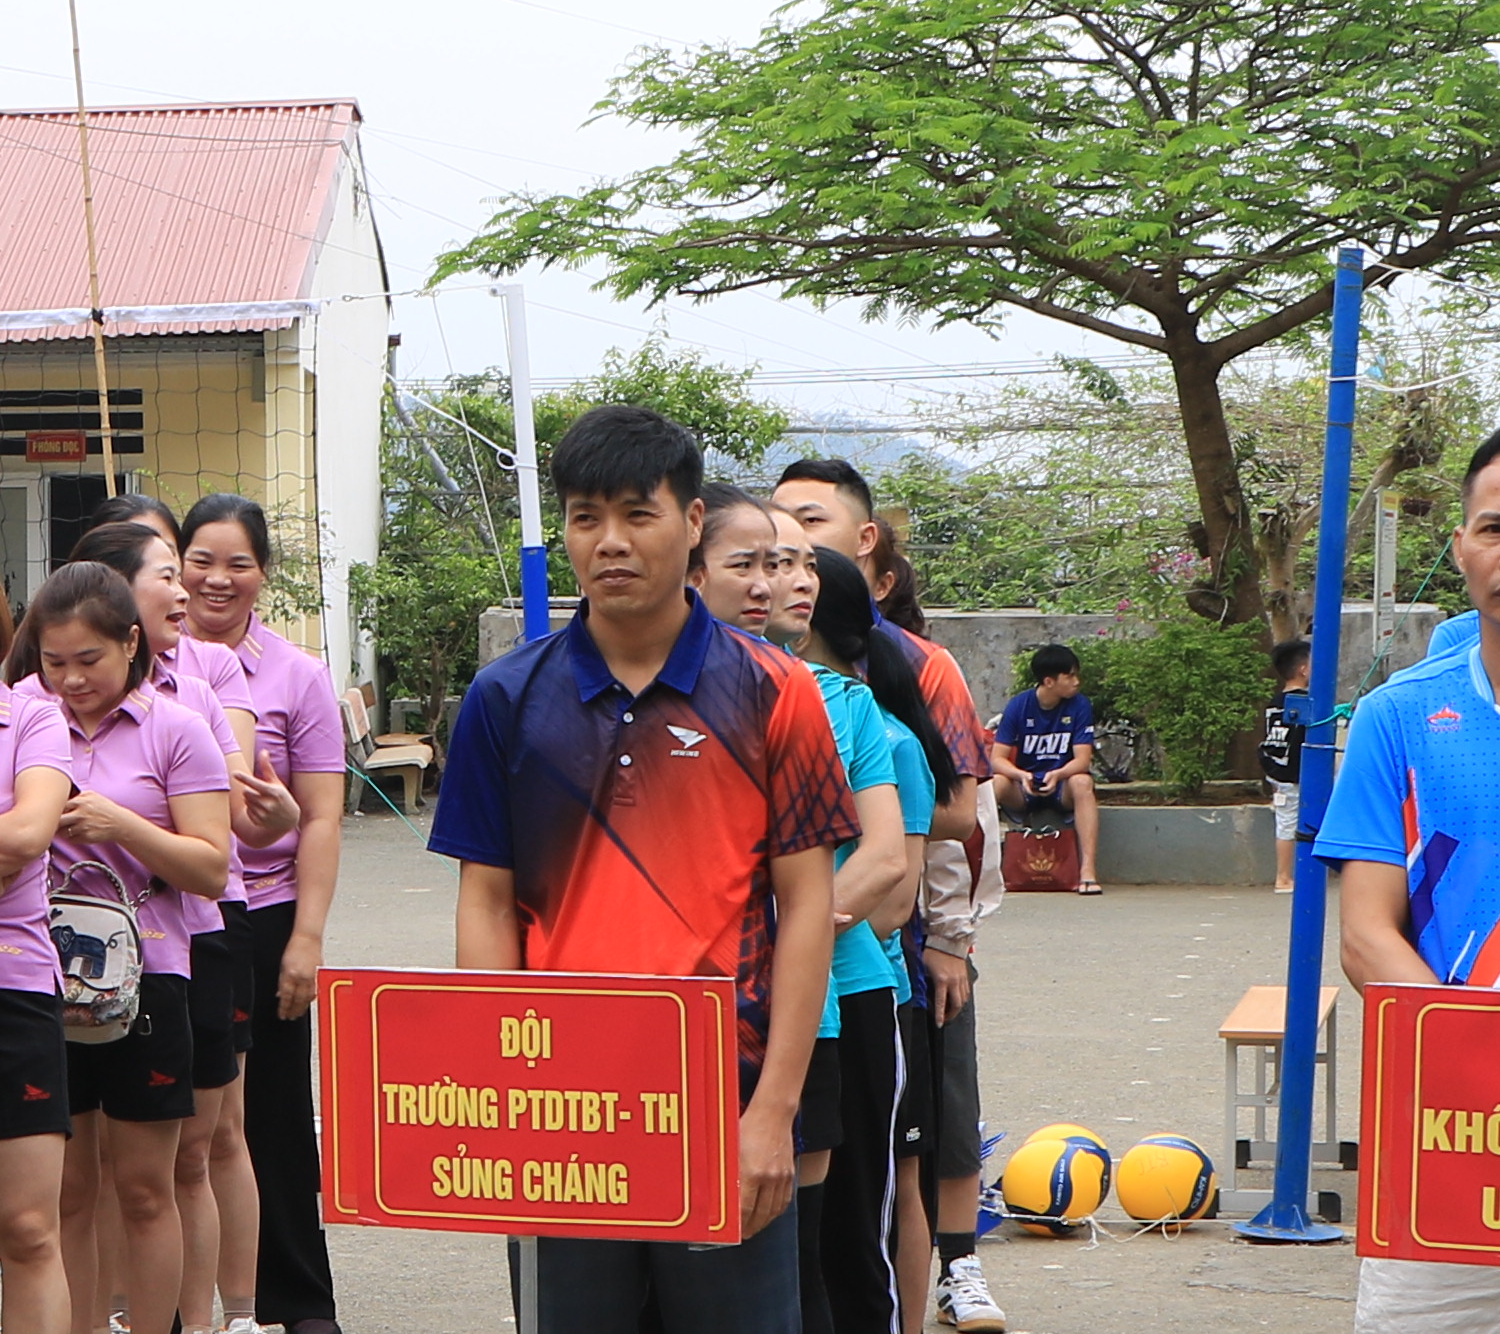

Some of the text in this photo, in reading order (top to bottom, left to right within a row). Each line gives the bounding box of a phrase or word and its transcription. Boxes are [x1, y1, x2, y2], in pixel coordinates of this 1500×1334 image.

[499, 1008, 551, 1068] ĐỘI
[382, 1075, 679, 1134] TRƯỜNG PTDTBT- TH
[432, 1143, 628, 1204] SỦNG CHÁNG
